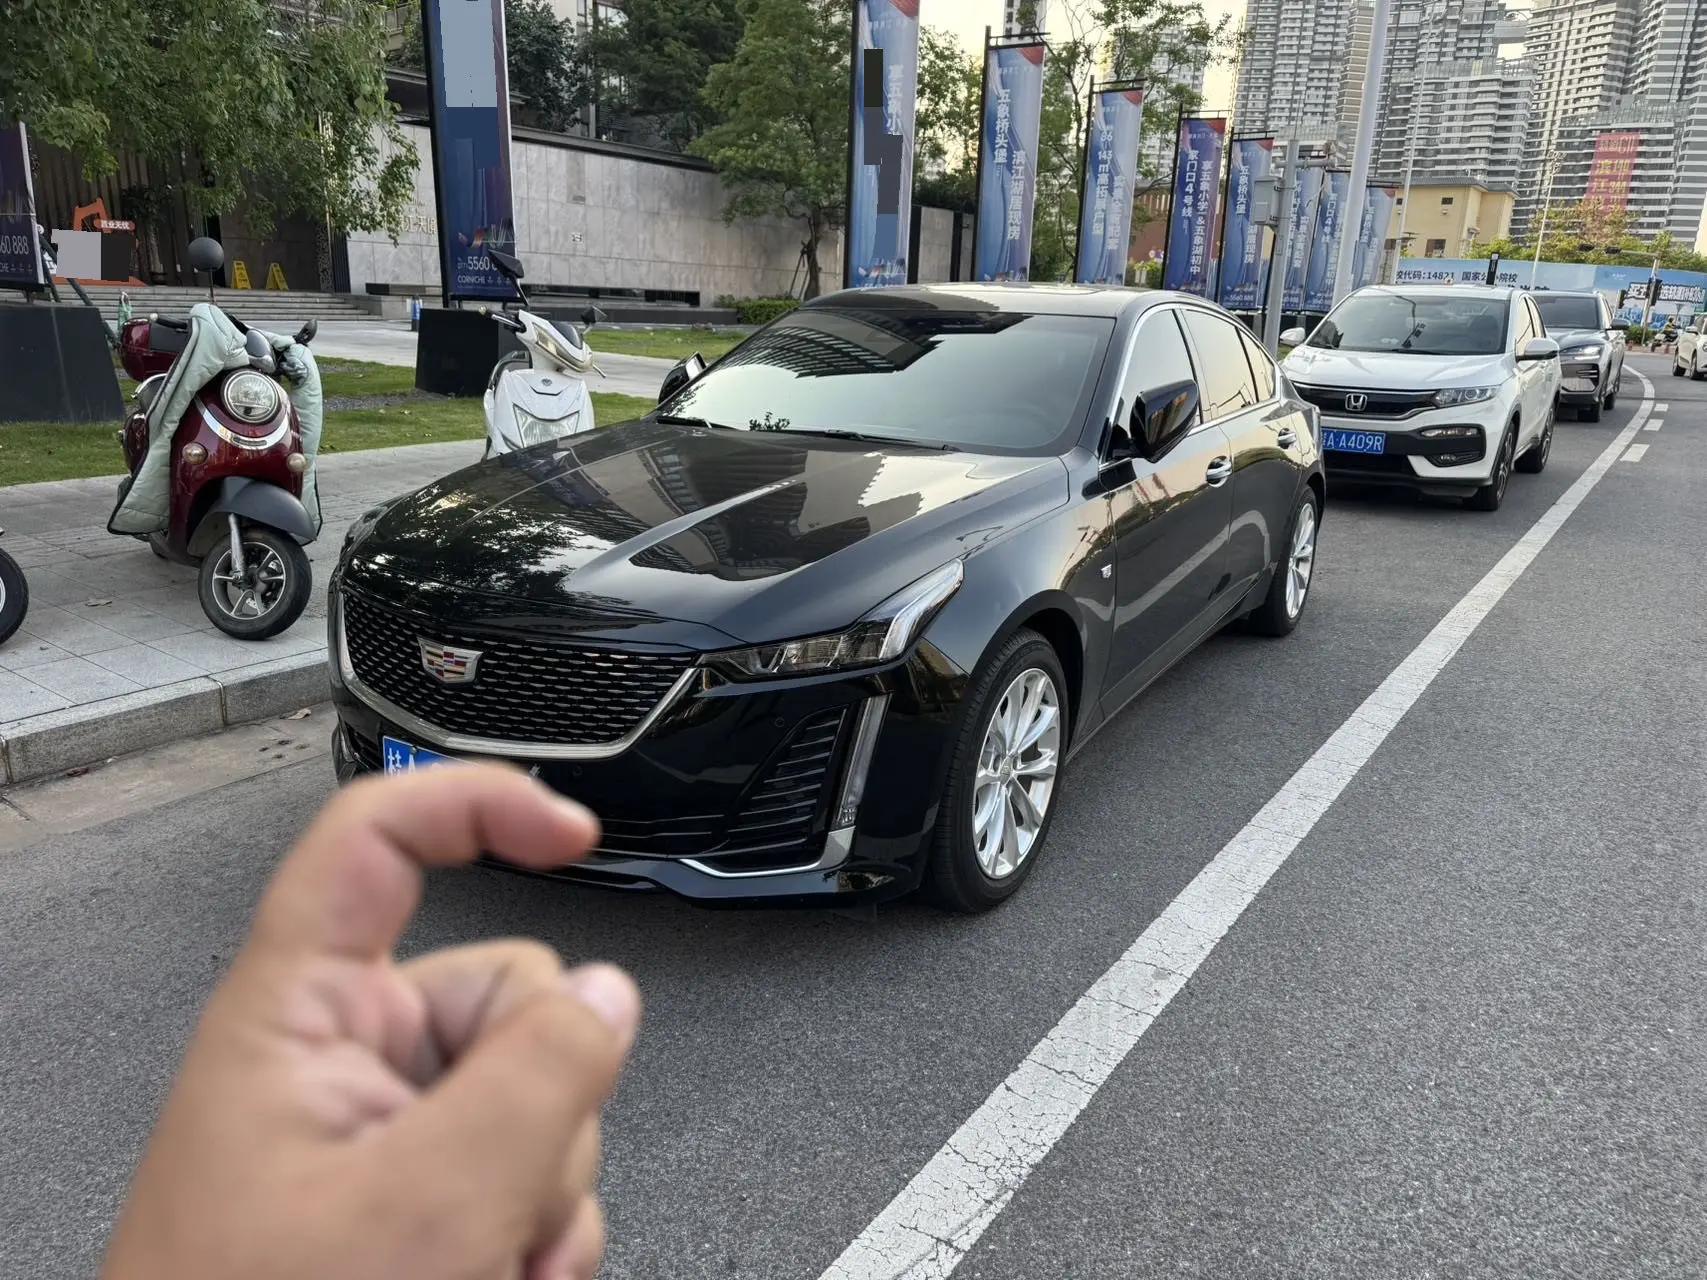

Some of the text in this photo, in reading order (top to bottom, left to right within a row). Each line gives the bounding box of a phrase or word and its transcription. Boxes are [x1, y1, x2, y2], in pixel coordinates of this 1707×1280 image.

[994, 88, 1011, 163] 五象桥头堡
[1007, 150, 1026, 240] 滨江湖居现房
[1182, 150, 1199, 217] 家门口4号线
[1236, 165, 1249, 214] 五象桥头堡
[12, 235, 29, 255] 888
[467, 256, 490, 270] 5560
